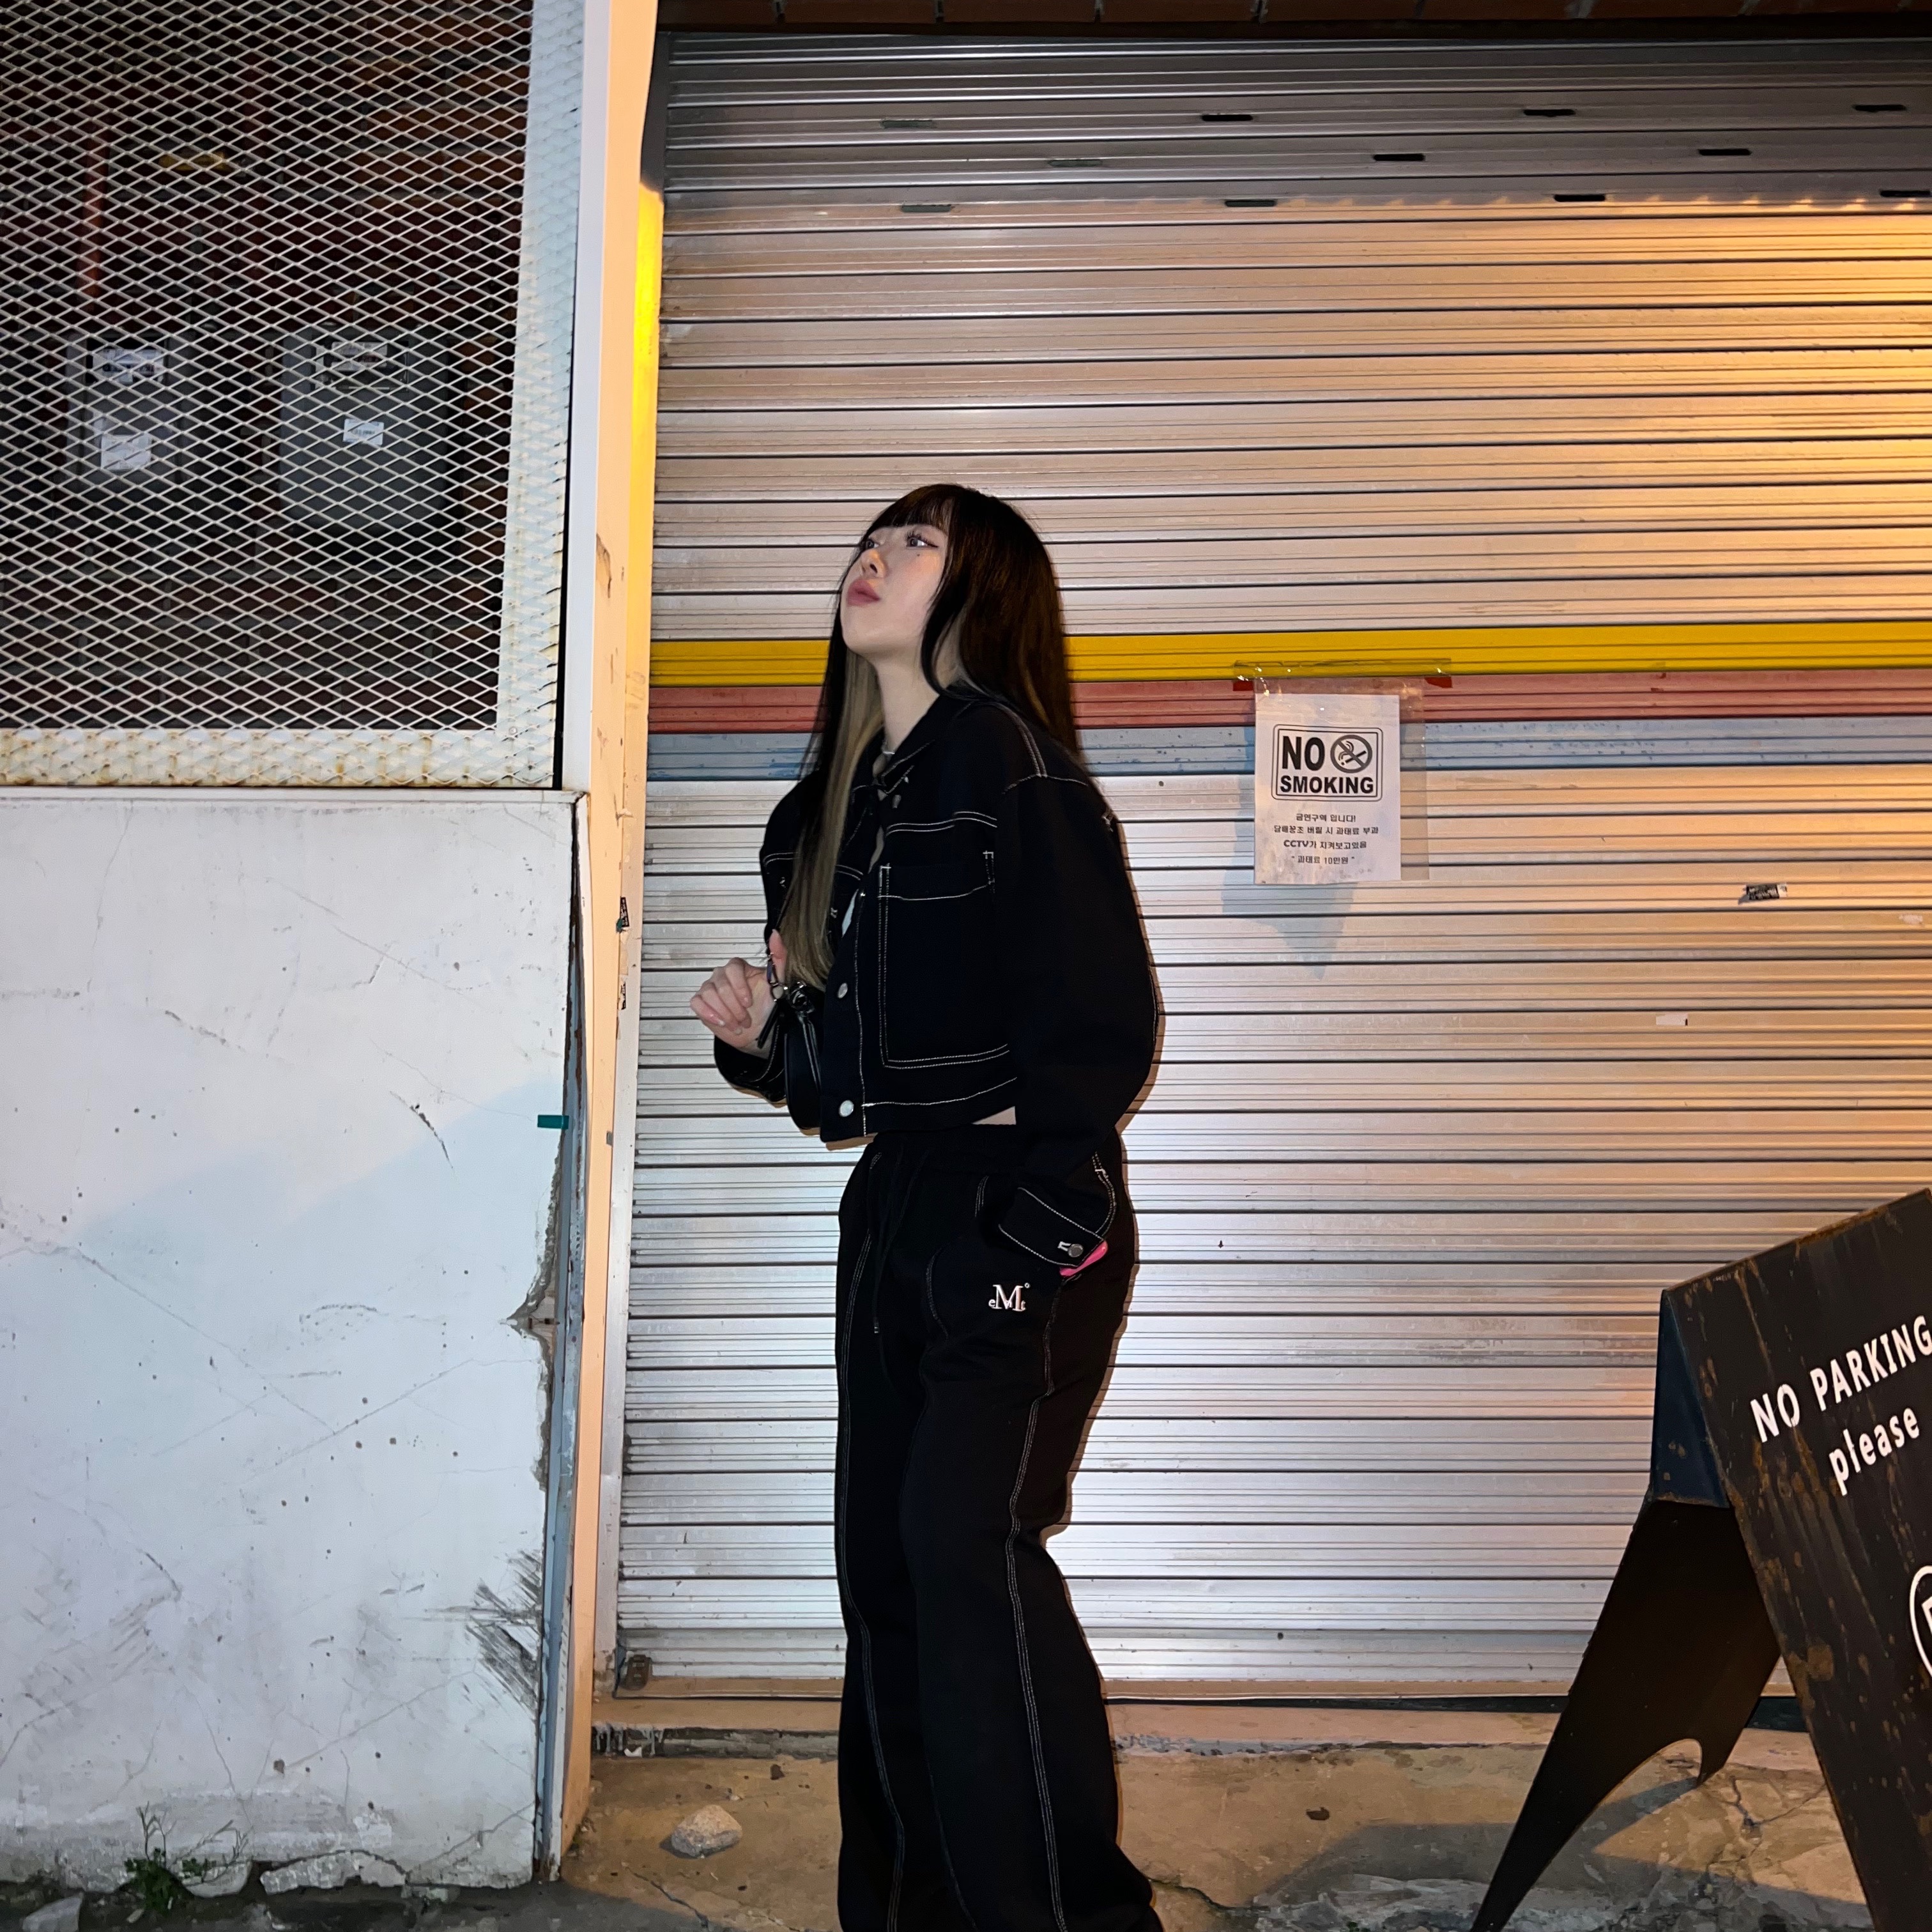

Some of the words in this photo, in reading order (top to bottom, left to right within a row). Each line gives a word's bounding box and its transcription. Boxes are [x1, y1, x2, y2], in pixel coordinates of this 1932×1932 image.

[1282, 735, 1326, 771] NO
[1280, 775, 1374, 794] SMOKING
[1296, 813, 1327, 822] 금연구역
[1325, 827, 1333, 835] 시
[1336, 827, 1360, 835] 과태료
[1283, 839, 1317, 849] CCTV가
[1298, 855, 1321, 864] 과태료
[1324, 856, 1349, 864] 10만원
[1750, 1384, 1800, 1443] NO
[1809, 1315, 1932, 1412] PARKING
[1828, 1407, 1919, 1496] please
